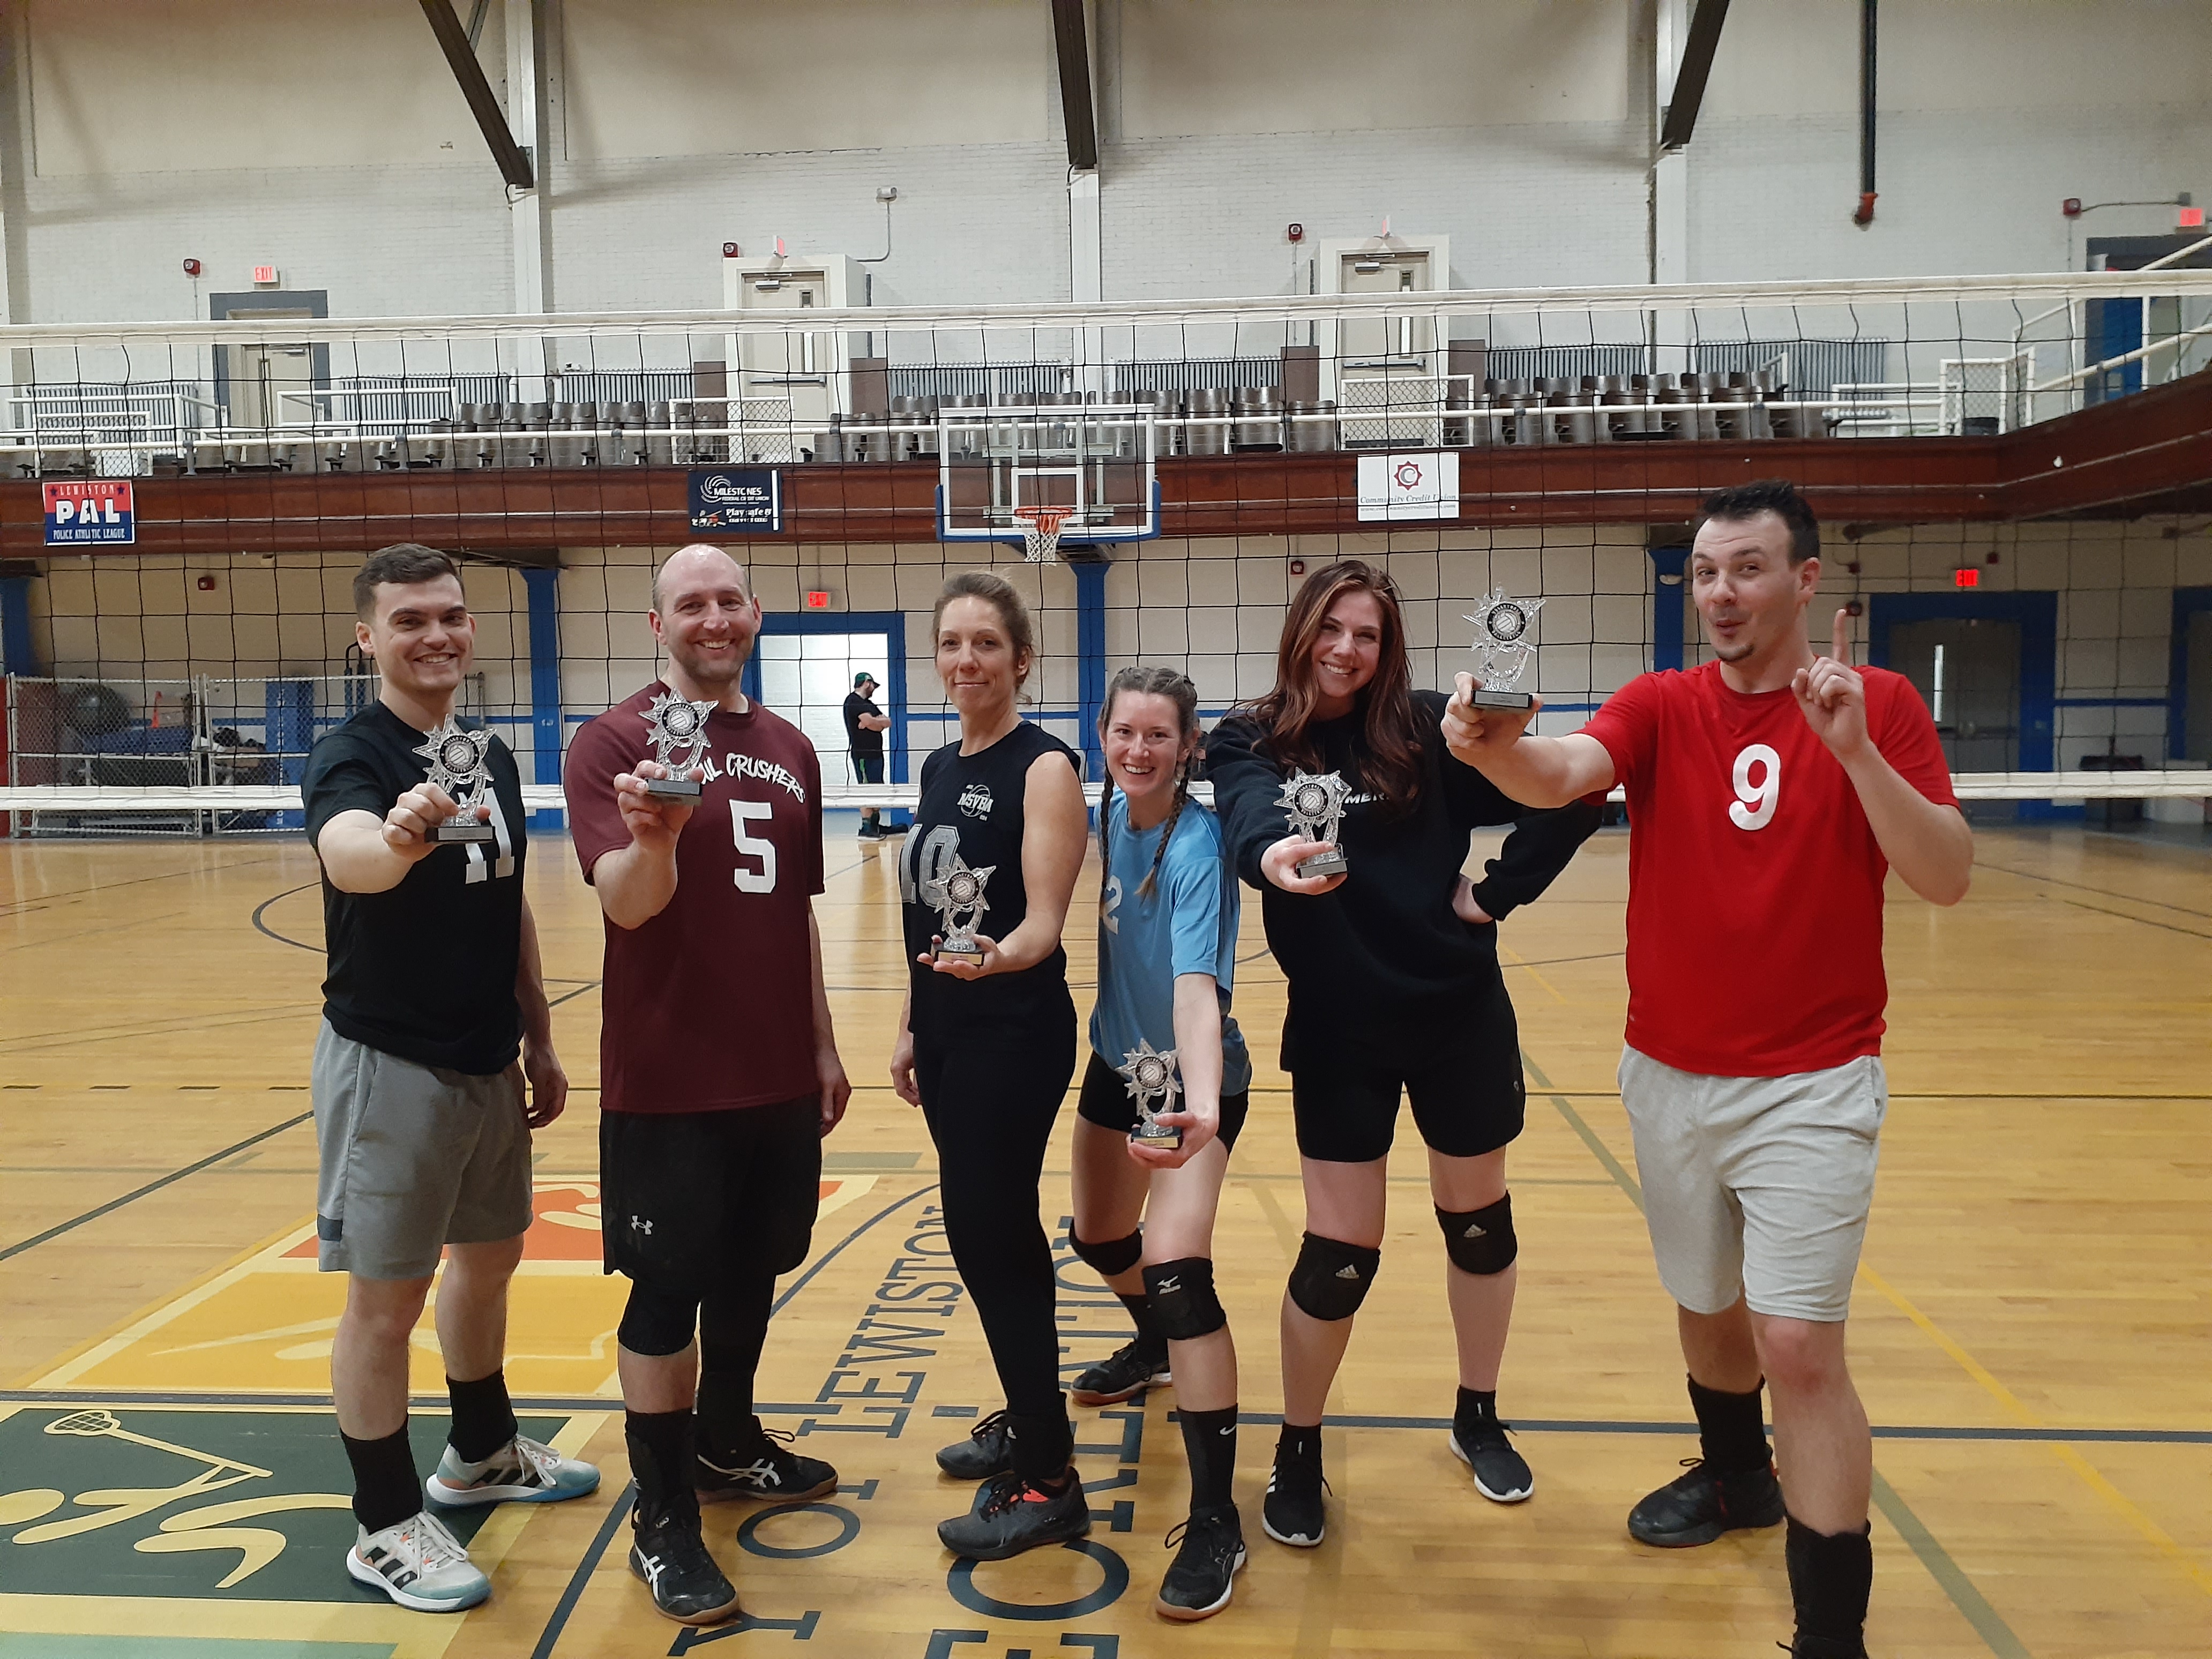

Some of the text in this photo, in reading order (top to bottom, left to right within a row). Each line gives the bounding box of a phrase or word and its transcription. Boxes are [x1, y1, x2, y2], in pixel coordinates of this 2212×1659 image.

[255, 267, 272, 281] EXIT
[60, 484, 114, 496] LEWISTON
[1406, 494, 1430, 502] Credit
[56, 499, 120, 524] PAL
[53, 529, 73, 540] POLICE
[103, 528, 125, 539] LEAGUE
[726, 753, 806, 804] CRUSHERS
[1729, 743, 1781, 831] 9
[729, 799, 776, 893] 5
